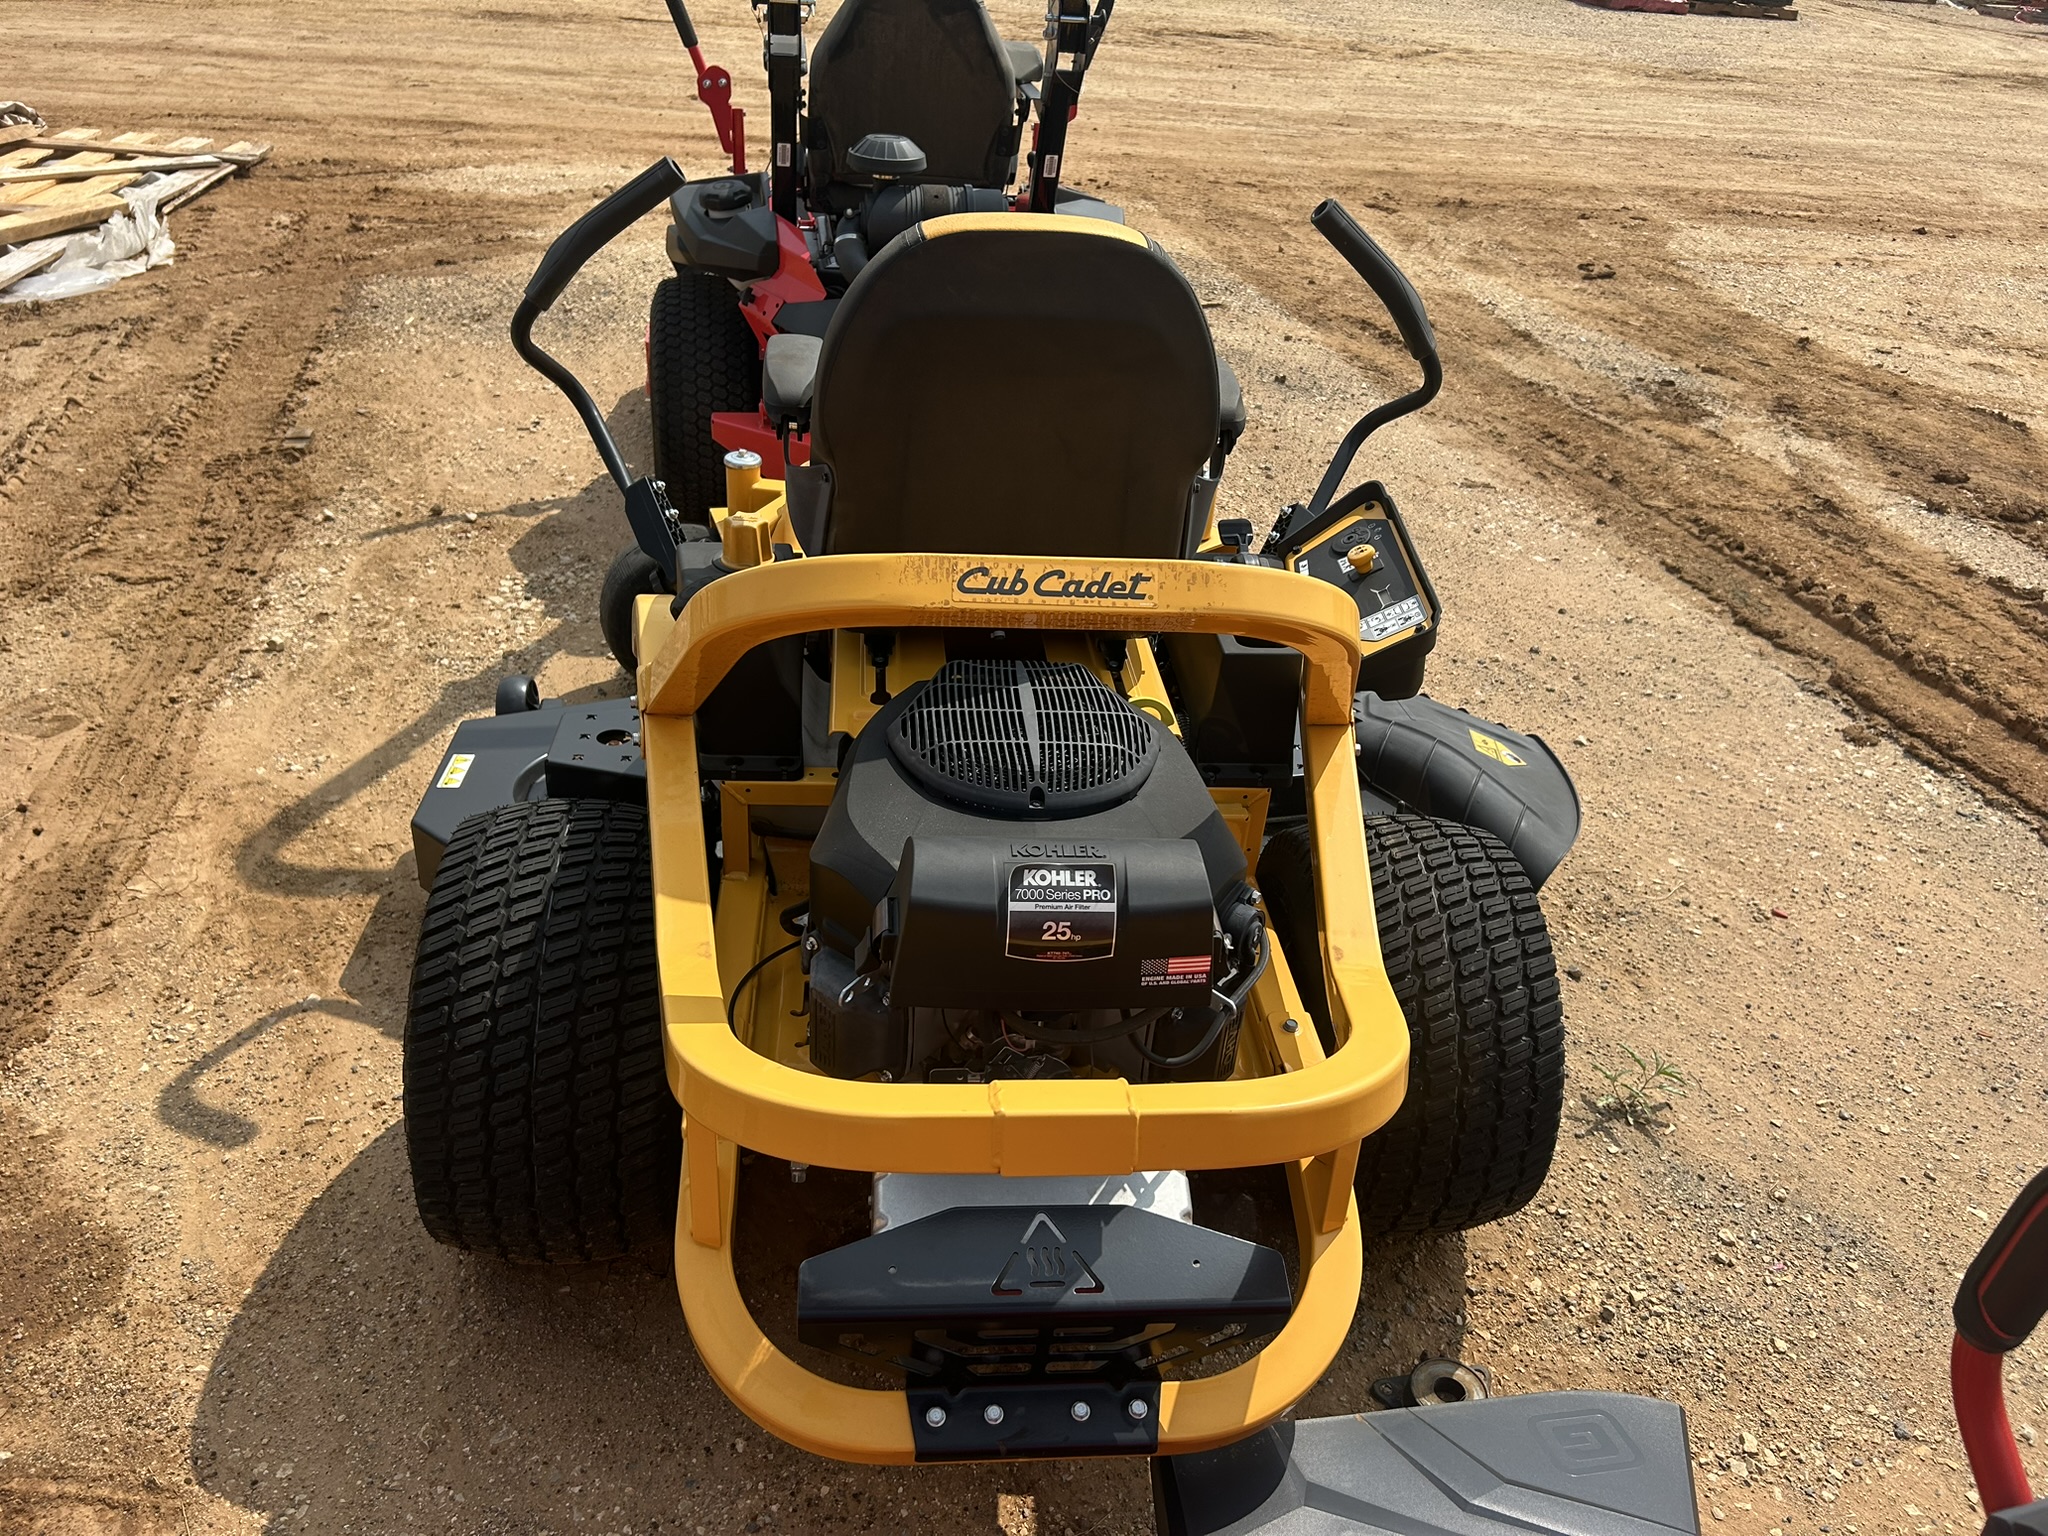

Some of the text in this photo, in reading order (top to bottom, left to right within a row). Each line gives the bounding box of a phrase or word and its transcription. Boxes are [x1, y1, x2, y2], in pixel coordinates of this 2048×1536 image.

[956, 566, 1151, 601] Cub Cadet
[1010, 843, 1105, 858] KOHLER
[1023, 869, 1099, 887] KOHLER
[1015, 888, 1111, 901] 7000 Series PRO
[1034, 903, 1091, 911] Premium Air Filter
